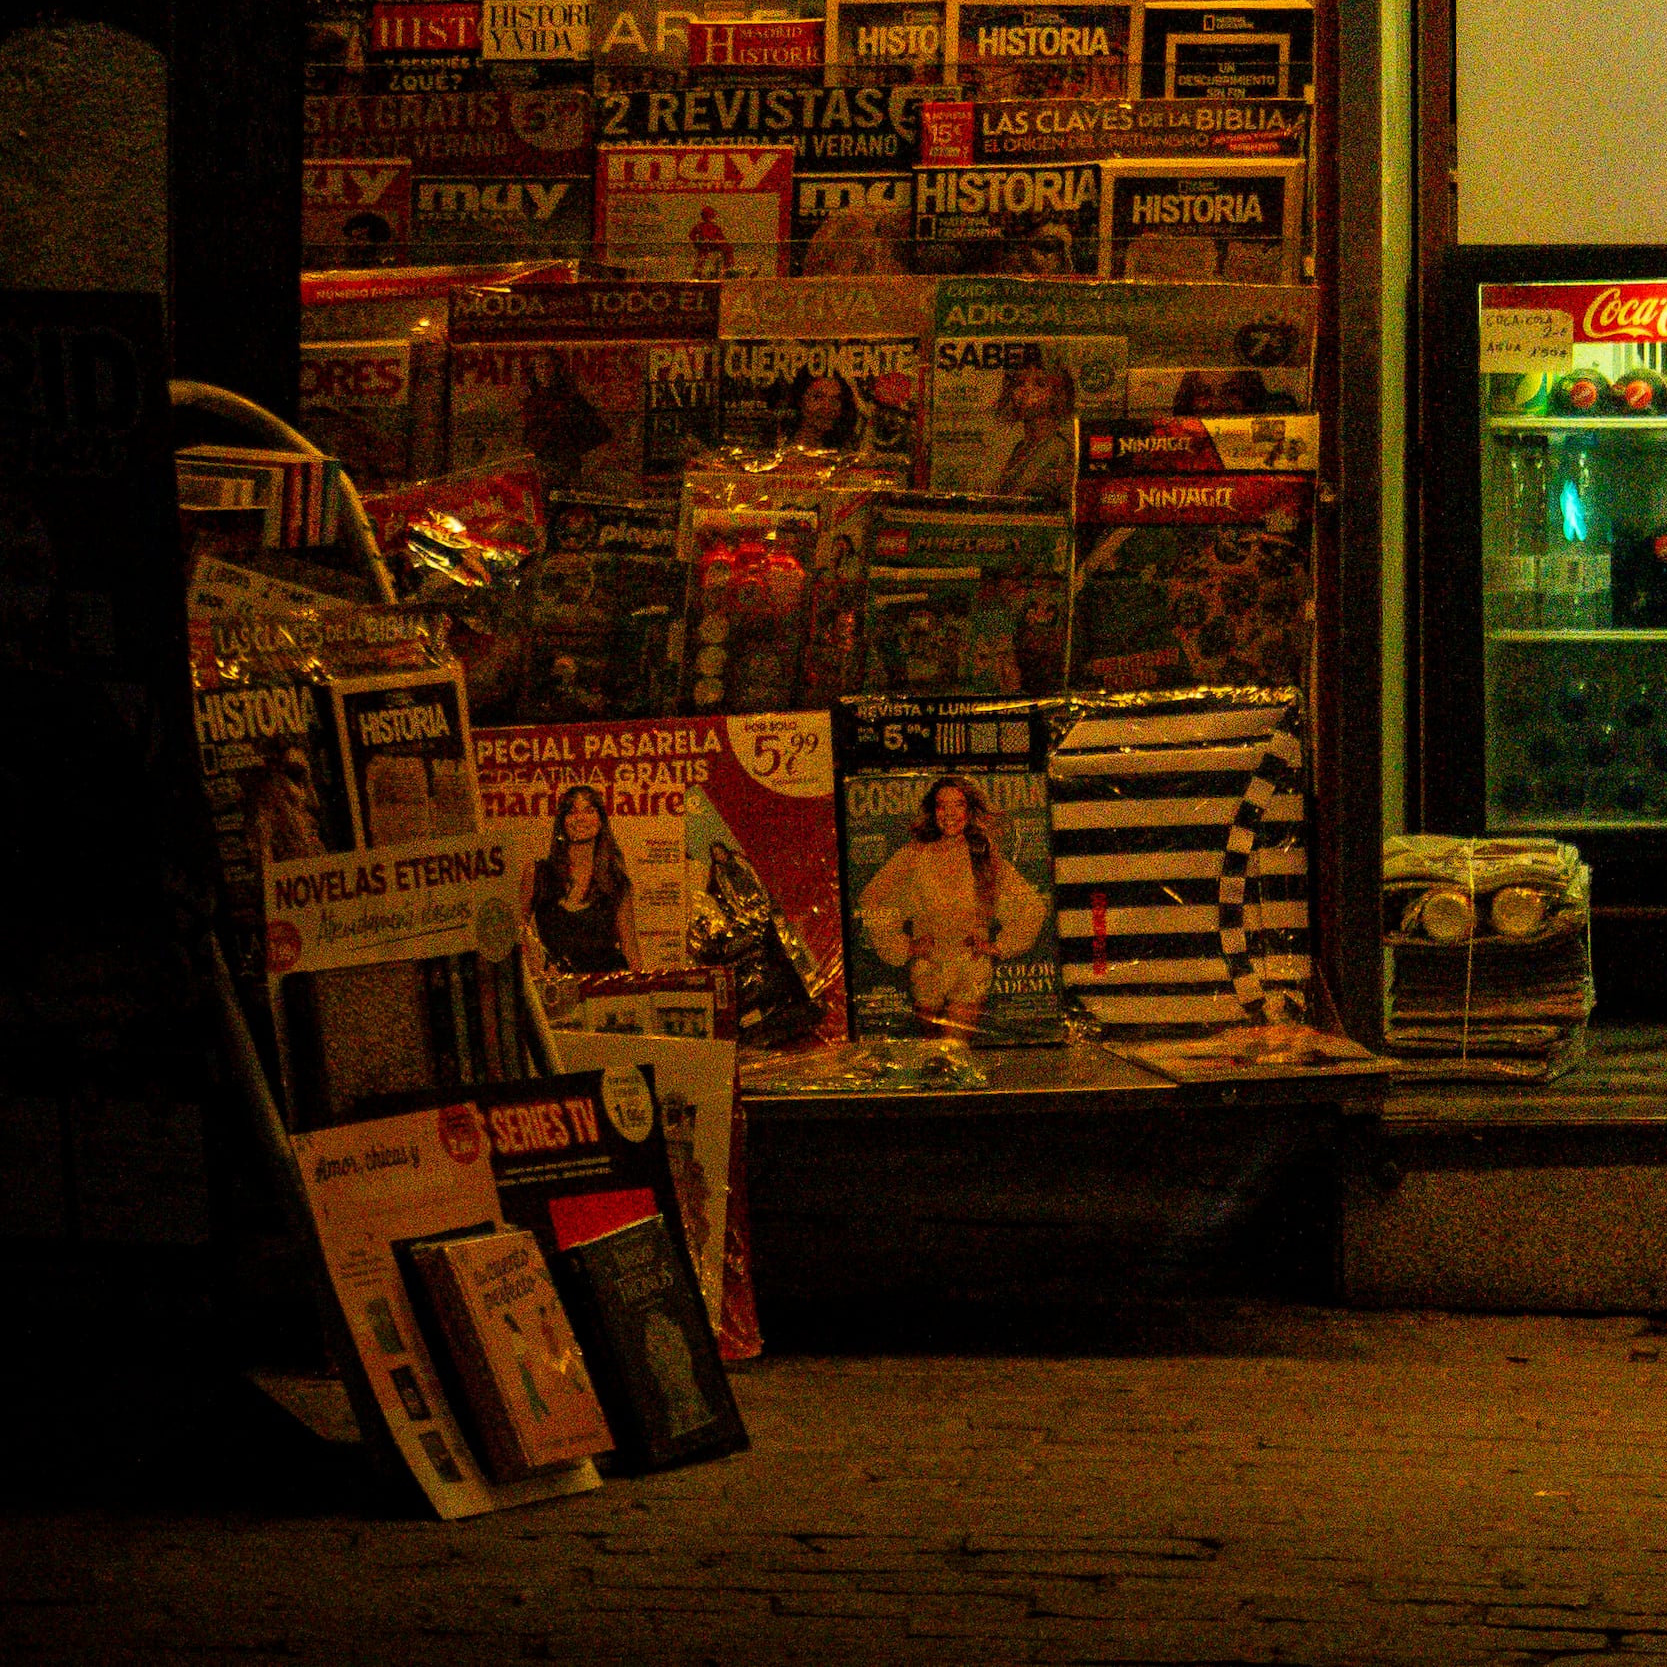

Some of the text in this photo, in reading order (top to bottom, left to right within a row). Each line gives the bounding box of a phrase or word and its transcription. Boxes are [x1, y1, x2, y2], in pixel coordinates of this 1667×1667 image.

[978, 27, 1109, 56] HISTORIA
[603, 95, 630, 135] 2
[647, 88, 884, 132] REVISTAS
[982, 111, 1028, 136] LAS
[1036, 109, 1134, 134] CLAVES
[1195, 108, 1285, 131] BIBLIA
[812, 134, 899, 157] VERANO
[607, 153, 781, 189] muy
[417, 183, 571, 220] muy
[917, 170, 1100, 212] HISTORIA
[1132, 195, 1263, 223] HISTORIA
[359, 705, 450, 745] HISTORIA
[584, 730, 722, 760] PASARELA
[613, 758, 709, 784] GRATIS
[275, 848, 505, 910] NOVELAS ETERNAS
[489, 1103, 568, 1154] SERIES
[566, 1097, 600, 1144] TV
